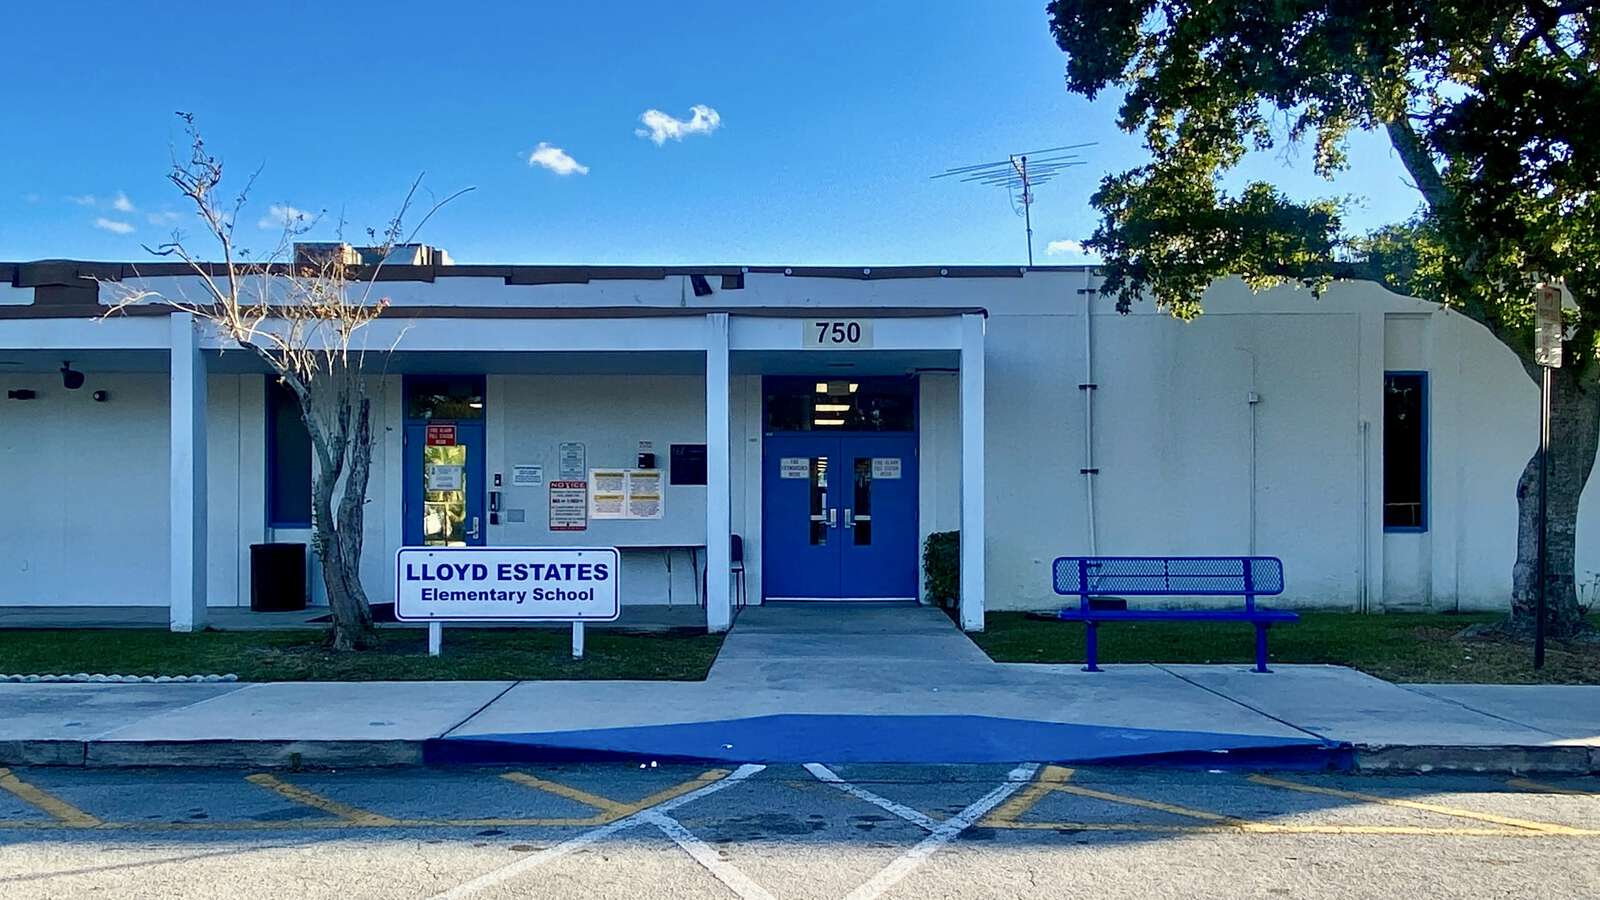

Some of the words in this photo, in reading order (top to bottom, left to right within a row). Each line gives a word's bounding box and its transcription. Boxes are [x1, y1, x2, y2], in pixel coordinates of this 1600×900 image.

[815, 322, 861, 344] 750
[406, 563, 488, 581] LLOYD
[497, 563, 609, 581] ESTATES
[421, 588, 527, 604] Elementary
[532, 588, 594, 601] School
